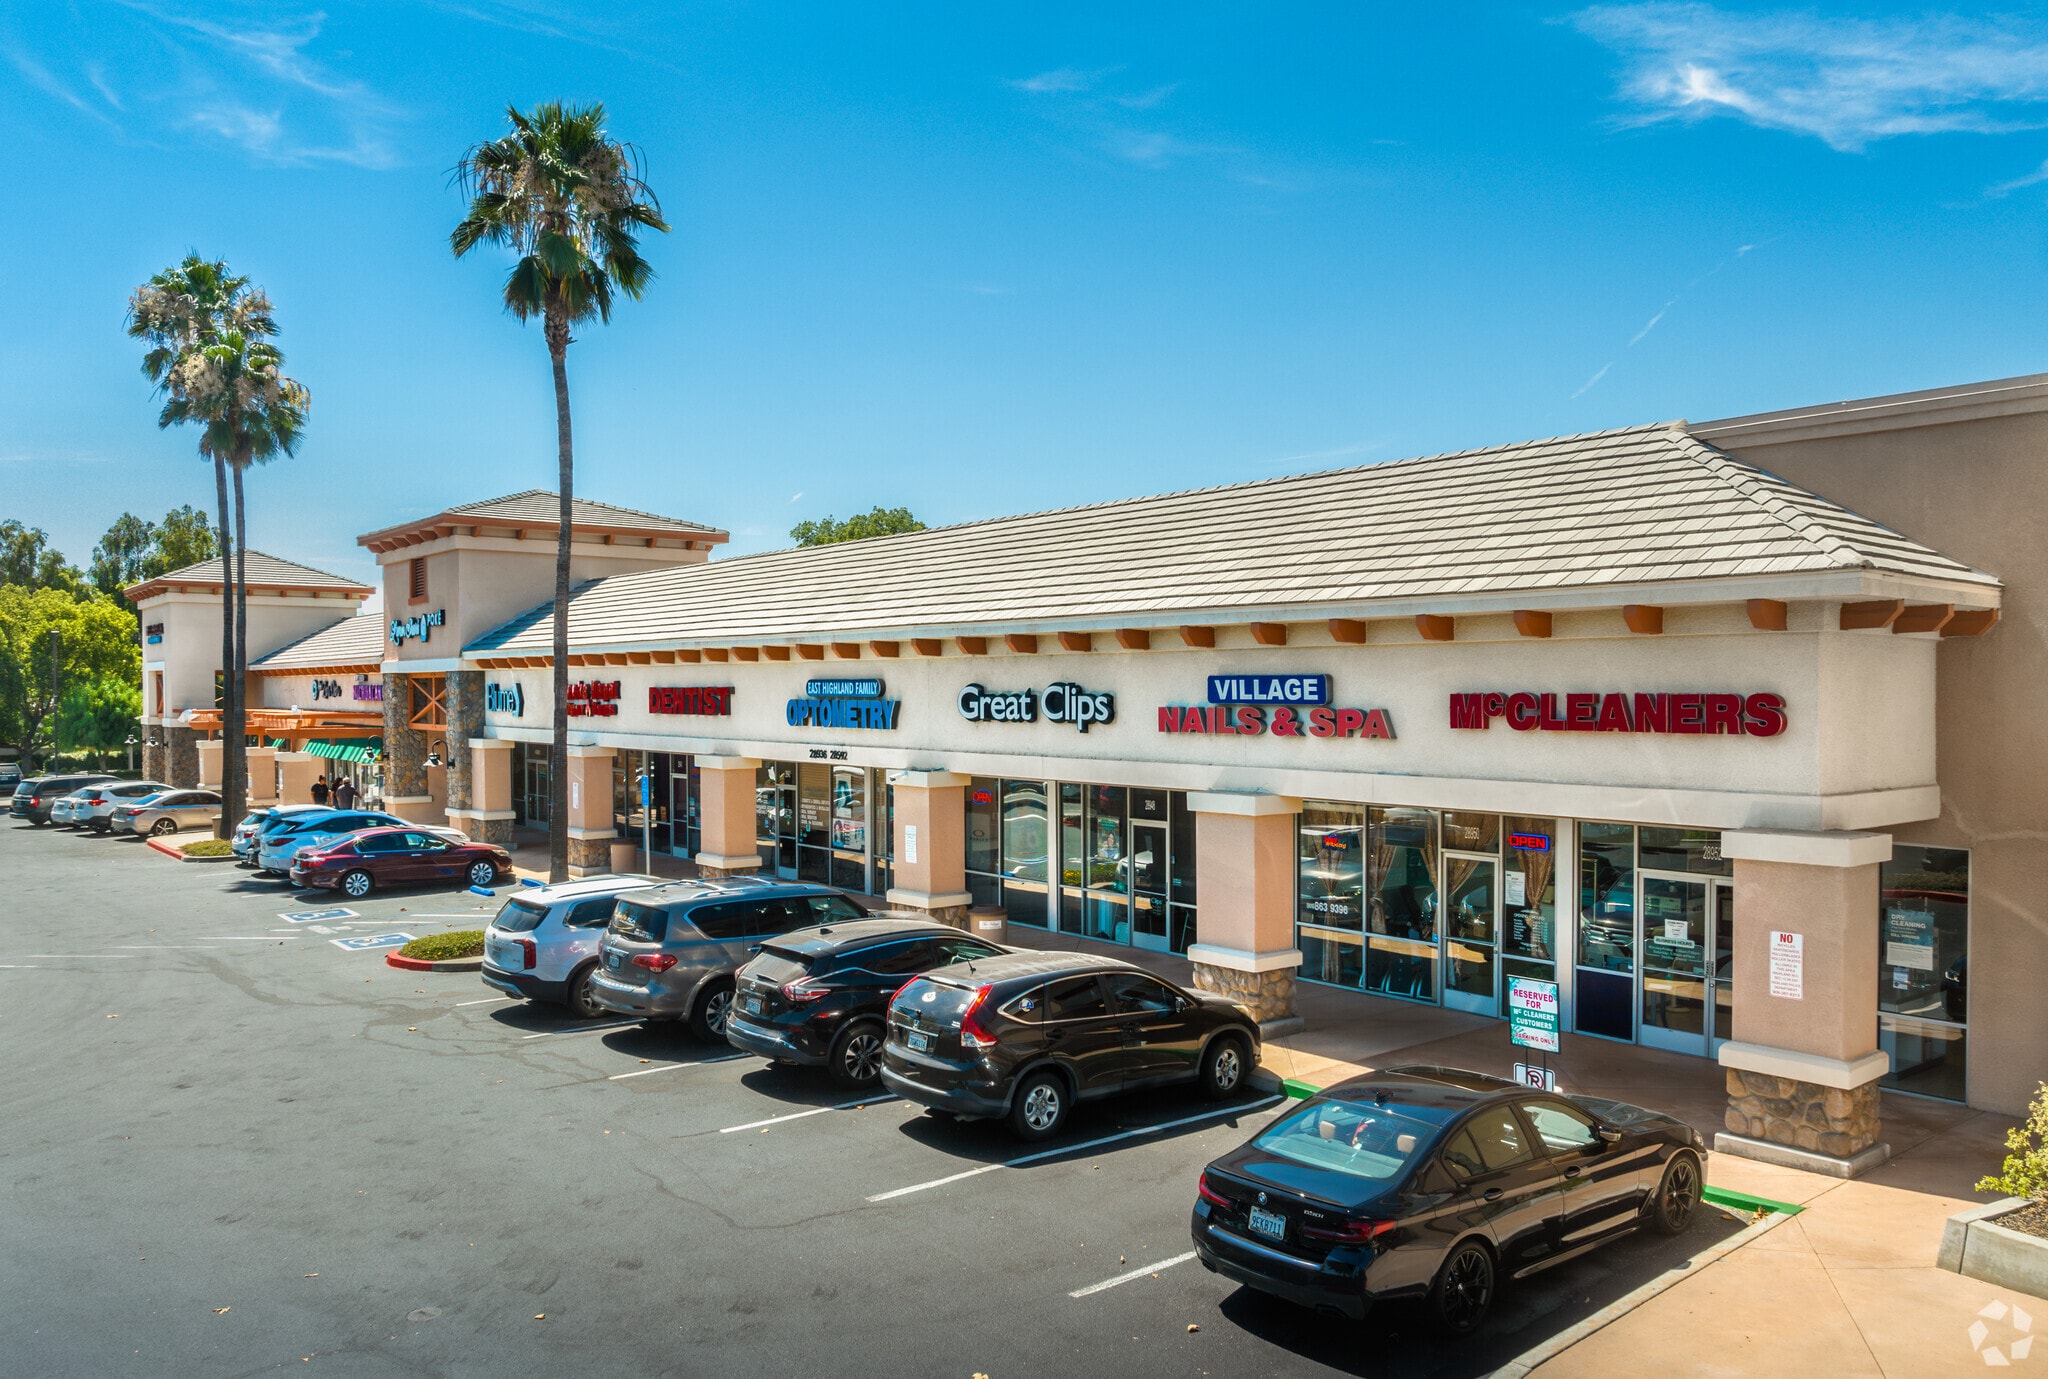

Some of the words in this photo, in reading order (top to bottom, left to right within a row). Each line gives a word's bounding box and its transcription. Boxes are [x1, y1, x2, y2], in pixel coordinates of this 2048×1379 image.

[807, 682, 821, 695] EAST
[822, 682, 854, 695] HIGHLAND
[855, 682, 878, 695] FAMILY
[1214, 678, 1319, 701] VILLAGE
[649, 686, 730, 716] DENTIST
[957, 685, 1032, 720] Great
[1041, 684, 1110, 731] Clips
[786, 698, 896, 730] OPTOMETRY
[1158, 705, 1262, 737] NAILS
[1270, 707, 1300, 737] &
[1308, 707, 1391, 740] SPA
[971, 791, 992, 803] OPEN
[1508, 835, 1546, 849] OPEN
[1314, 901, 1328, 912] 863
[1890, 920, 1926, 929] CLEANING
[1655, 937, 1677, 945] BUSINESS
[1780, 933, 1793, 944] NO
[1513, 989, 1554, 1003] RESERVED
[1525, 1000, 1541, 1009] FOR
[1523, 1009, 1555, 1022] CLEANERS
[1516, 1017, 1553, 1030] CUSTOMERS
[1515, 1033, 1539, 1042] PARKING
[1540, 1037, 1555, 1045] ONLY
